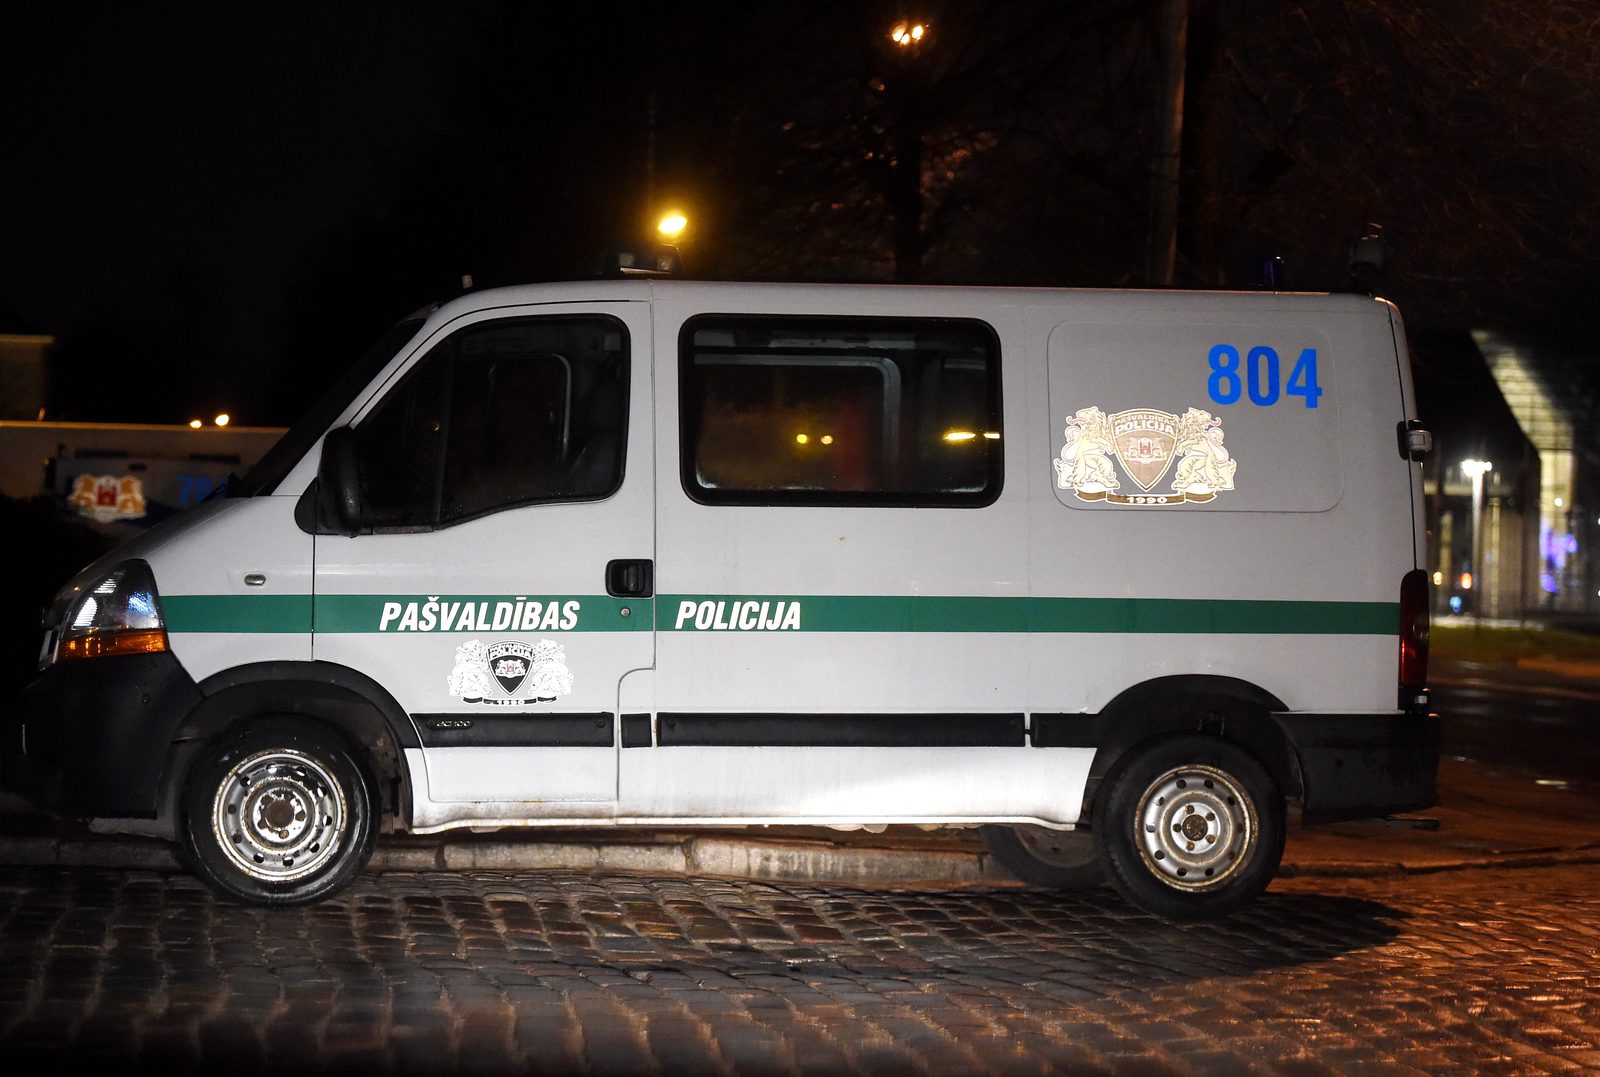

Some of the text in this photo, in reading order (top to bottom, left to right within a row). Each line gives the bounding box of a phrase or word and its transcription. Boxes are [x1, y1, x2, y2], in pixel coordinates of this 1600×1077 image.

[1207, 344, 1322, 408] 804
[1115, 420, 1175, 436] POLICIJA
[1126, 496, 1168, 504] 1990
[379, 596, 801, 631] PAŠVALDĪBAS POLICIJA
